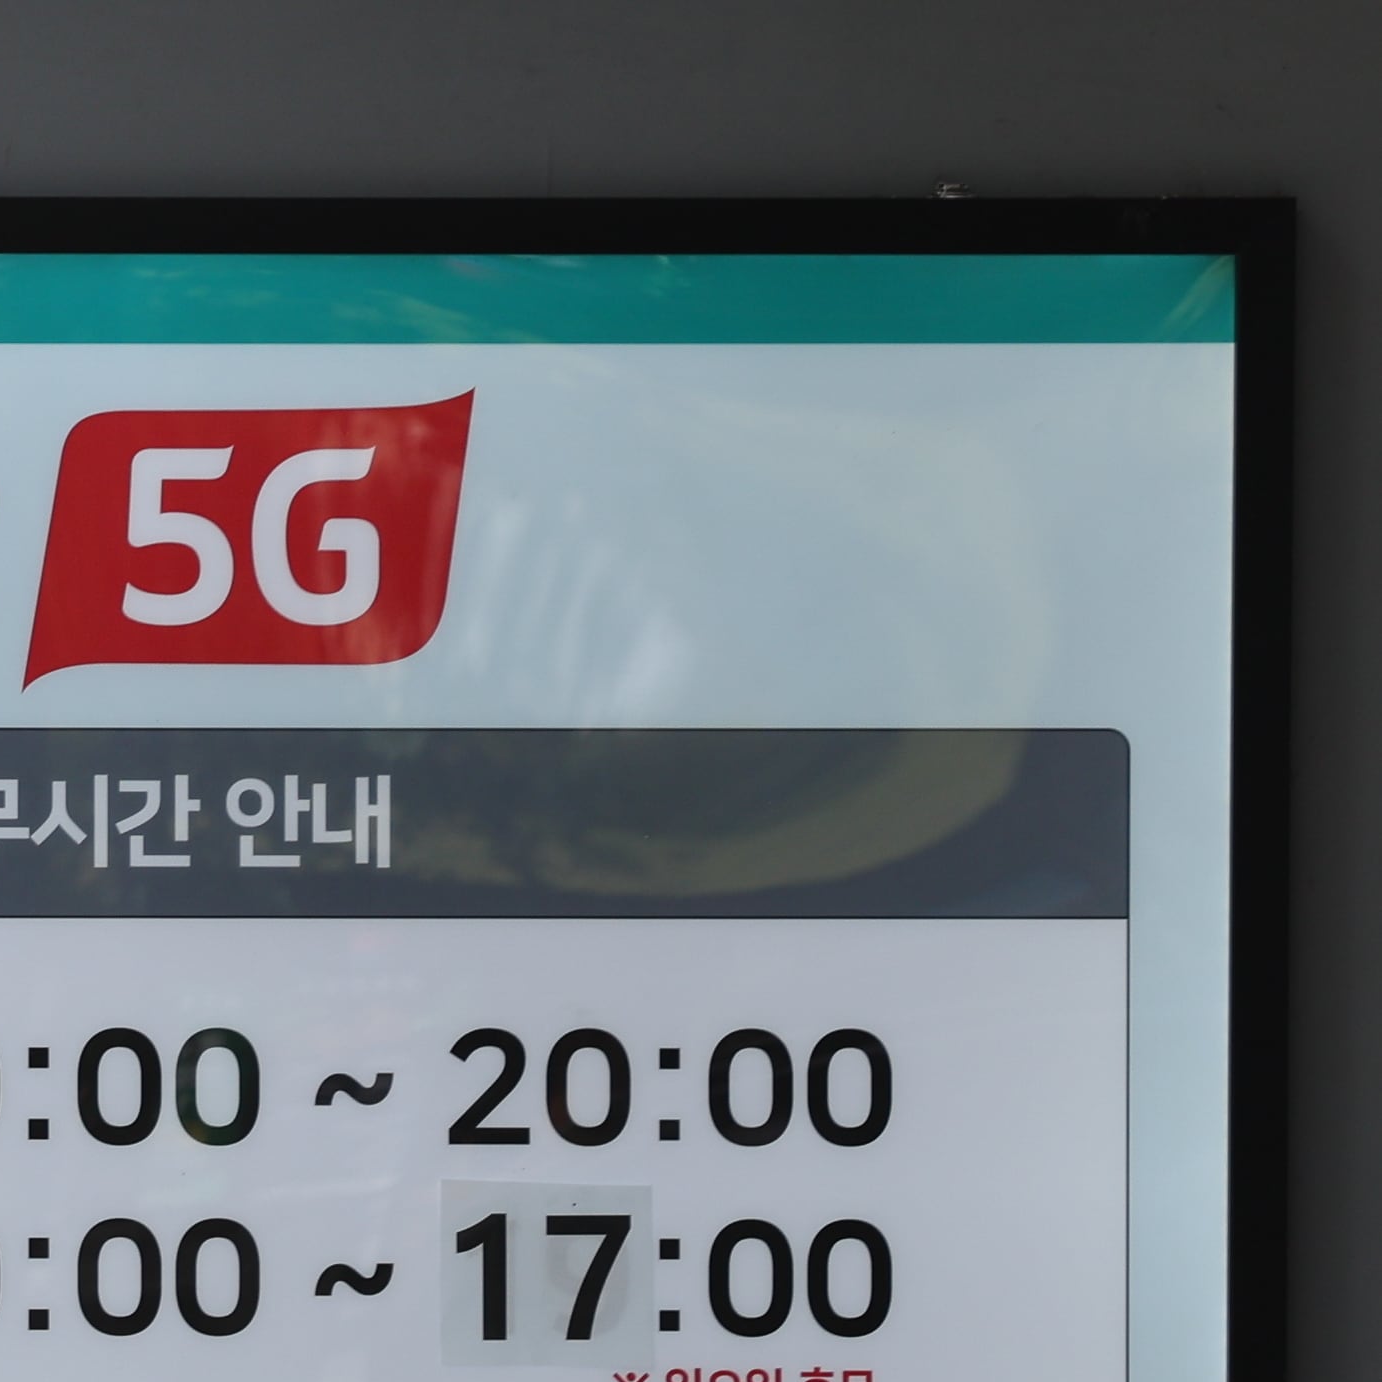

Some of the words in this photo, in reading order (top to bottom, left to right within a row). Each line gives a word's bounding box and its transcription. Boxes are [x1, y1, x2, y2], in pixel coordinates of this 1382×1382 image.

[122, 444, 382, 626] 5G
[226, 774, 391, 869] 안내
[448, 1027, 893, 1147] 20:00
[456, 1212, 893, 1342] 17:00
